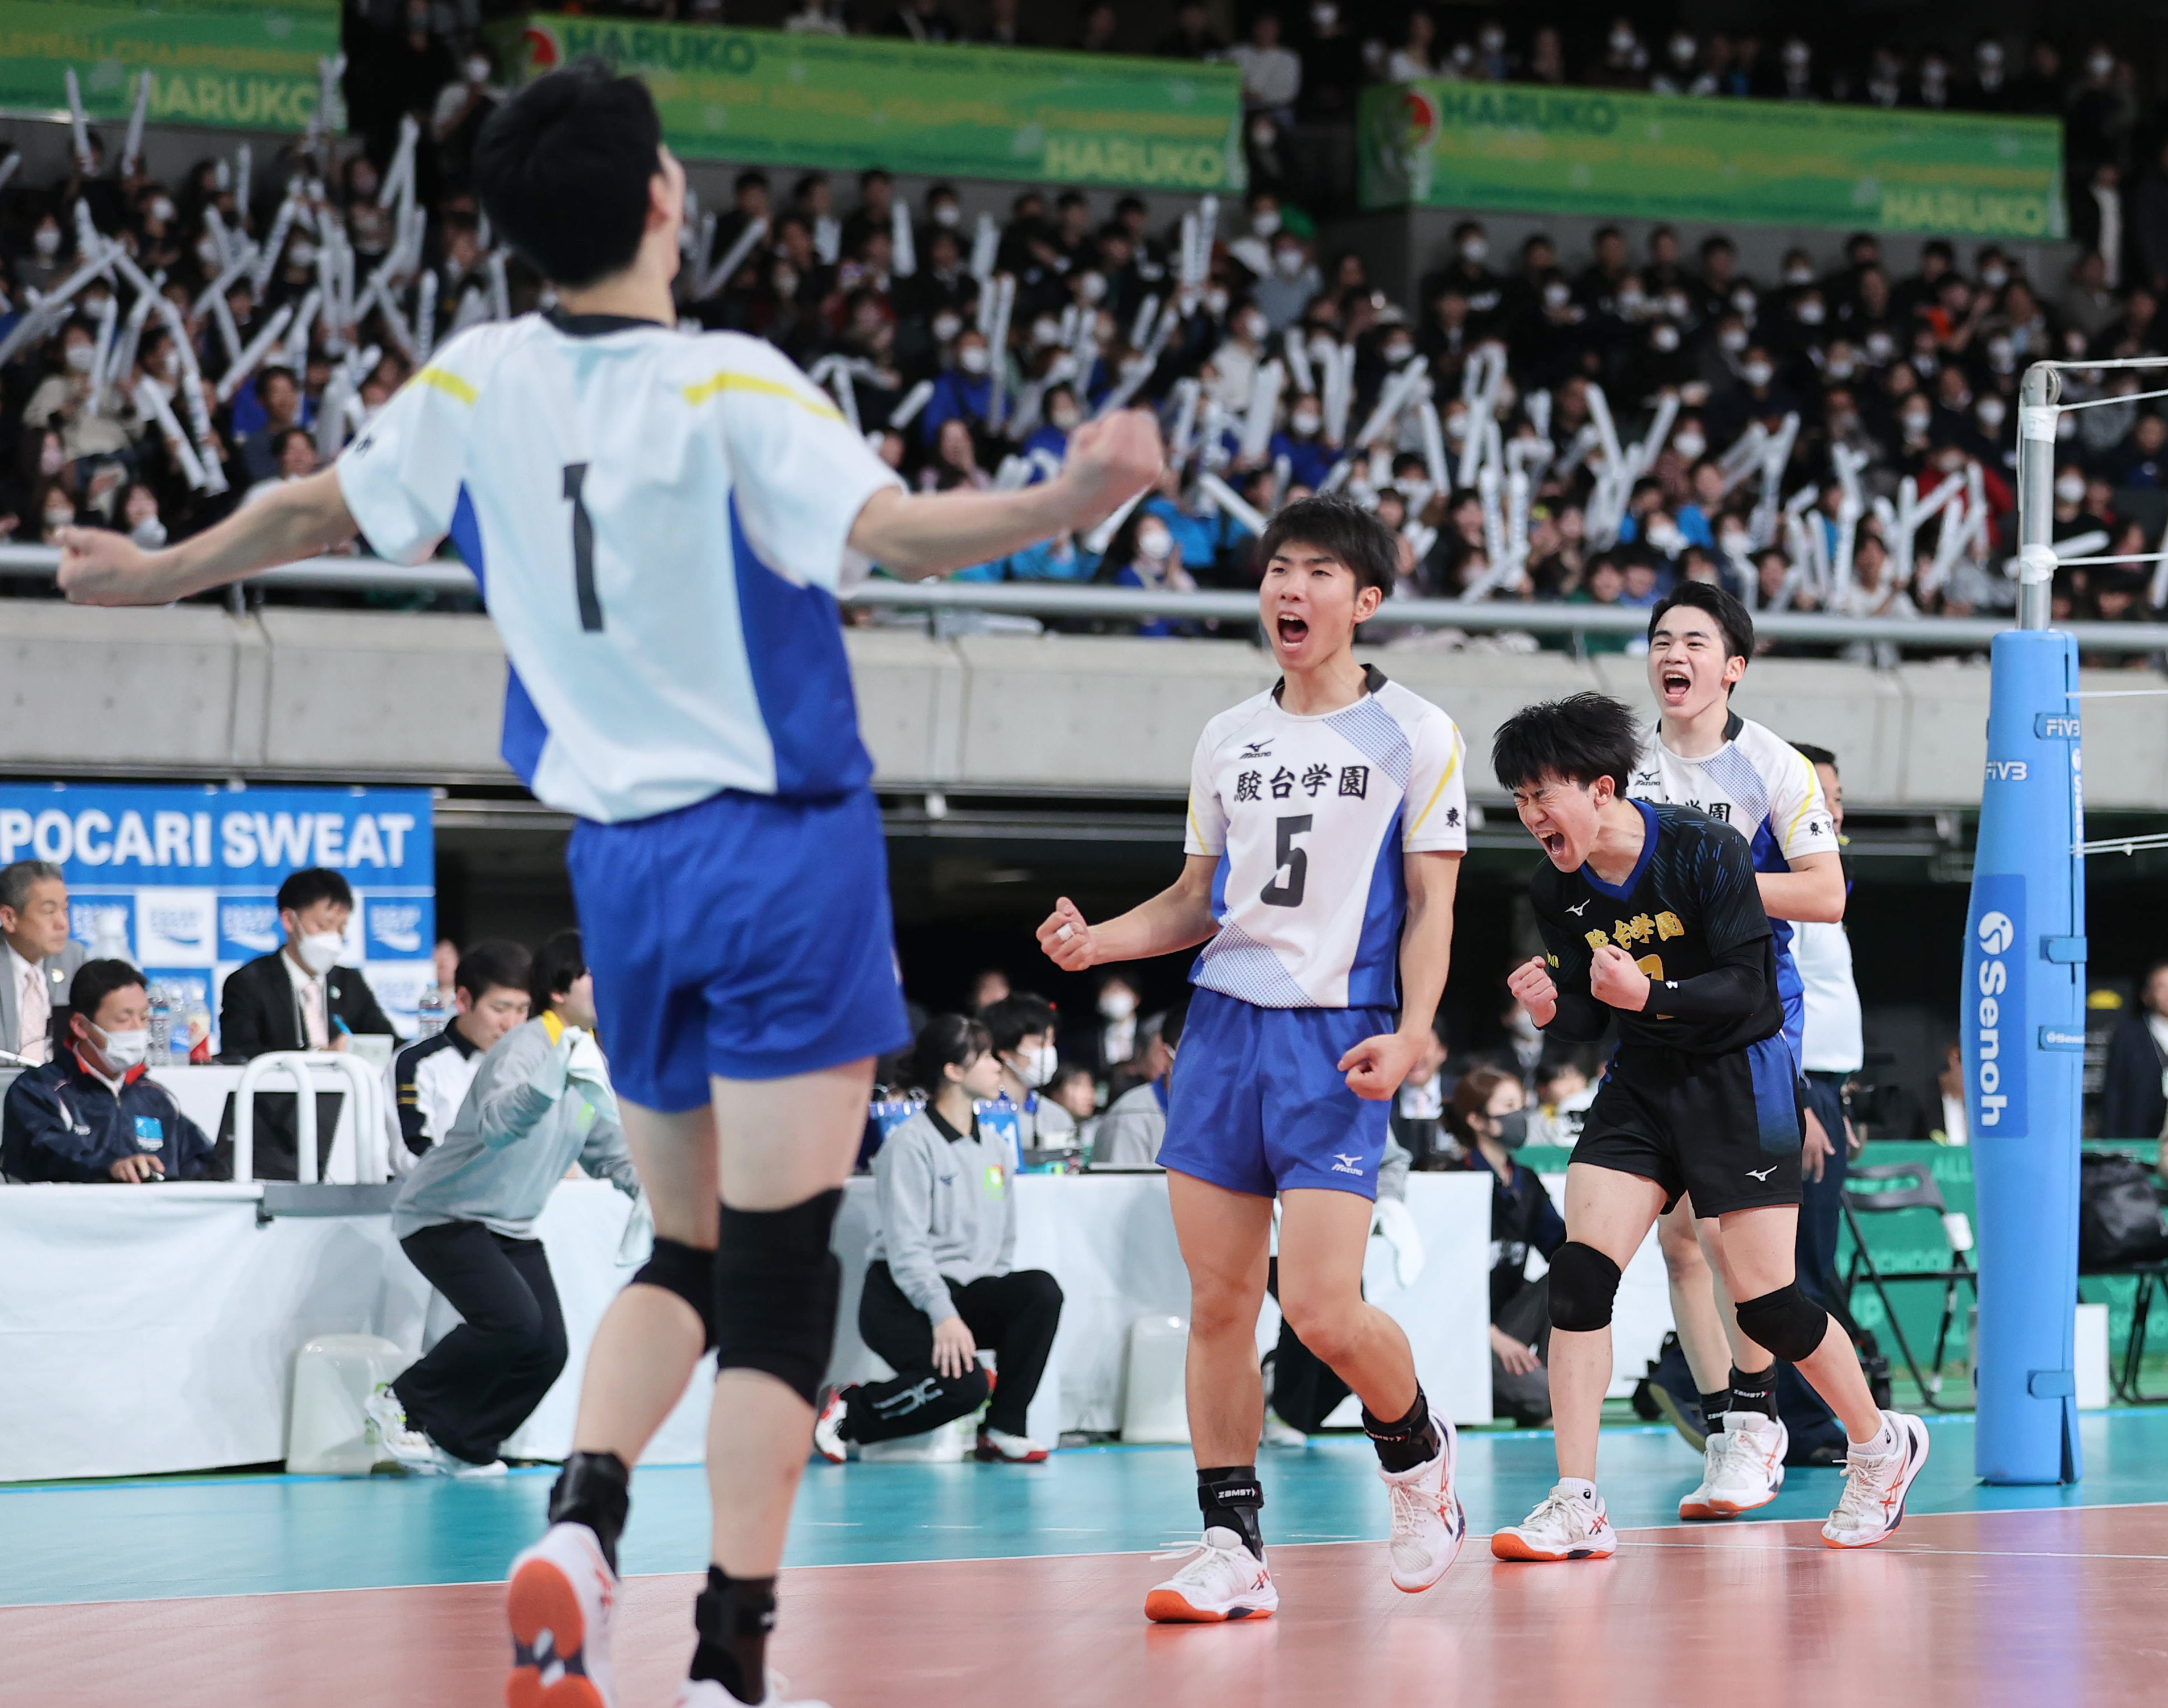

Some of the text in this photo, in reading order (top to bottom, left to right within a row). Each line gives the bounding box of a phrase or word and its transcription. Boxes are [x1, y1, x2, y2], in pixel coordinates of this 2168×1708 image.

[1043, 137, 1224, 187] HARUKO
[1881, 189, 2049, 234] HARUKO
[563, 462, 604, 633] 1
[1234, 763, 1370, 803] 駿台学園
[0, 808, 416, 869] POCARI SWEAT
[1259, 814, 1314, 908] 5
[1978, 959, 2008, 1127] Senoh
